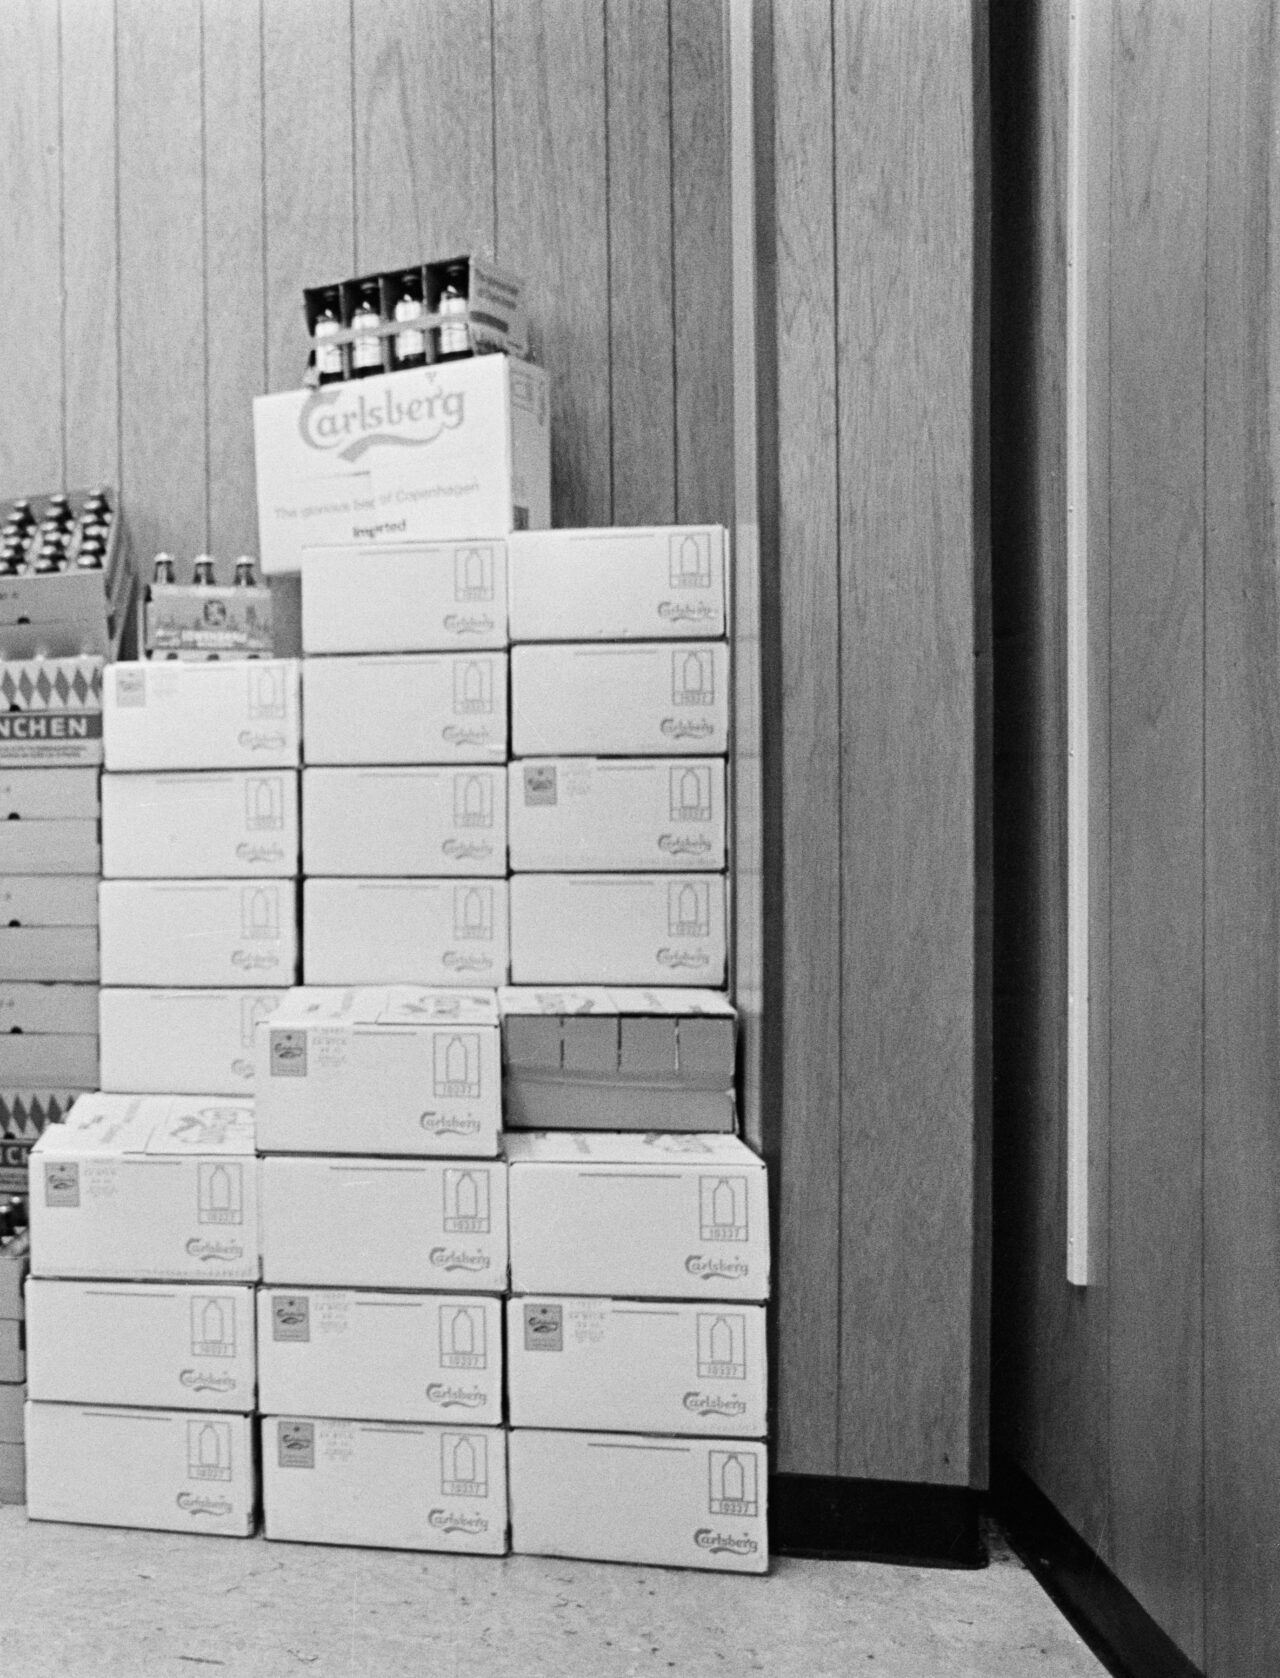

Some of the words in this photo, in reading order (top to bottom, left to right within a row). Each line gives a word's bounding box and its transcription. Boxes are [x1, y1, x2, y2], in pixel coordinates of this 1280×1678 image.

[298, 387, 466, 464] Carlsberg
[428, 1246, 491, 1273] Carlsberg
[684, 1254, 750, 1281] Carlsberg
[426, 1382, 488, 1409] Carlsberg
[682, 1391, 747, 1417] Carlsberg
[428, 1508, 489, 1535] Carlsberg
[693, 1527, 759, 1555] Carlsberg
